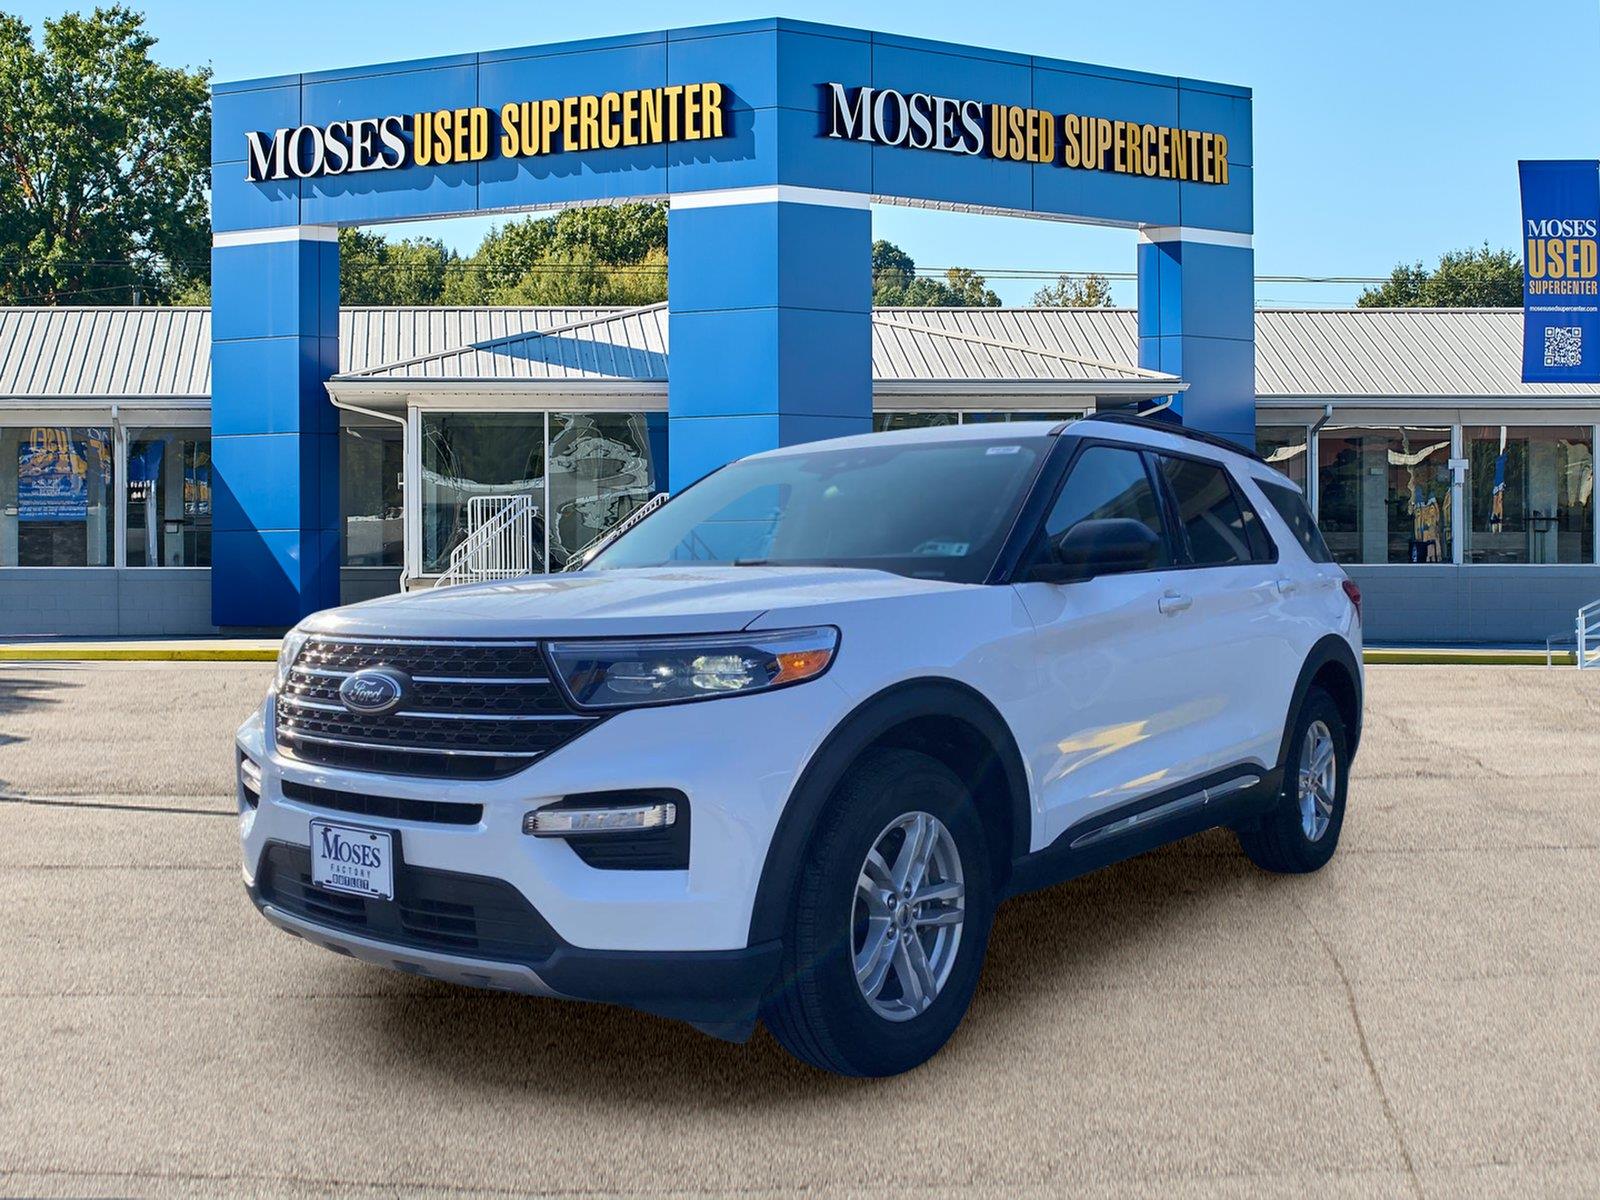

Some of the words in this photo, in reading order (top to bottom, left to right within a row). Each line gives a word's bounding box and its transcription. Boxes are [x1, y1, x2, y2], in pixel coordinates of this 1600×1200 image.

[244, 115, 406, 182] MOSES
[413, 107, 488, 166] USED
[500, 82, 723, 158] SUPERCENTER
[829, 82, 985, 155] MOSES
[991, 104, 1055, 164] USED
[1065, 113, 1229, 184] SUPERCENTER
[1527, 219, 1597, 237] MOSES
[1528, 239, 1597, 278] USED
[1529, 280, 1598, 295] SUPERCENTER
[349, 680, 384, 702] Ford
[330, 863, 371, 878] FACTORY
